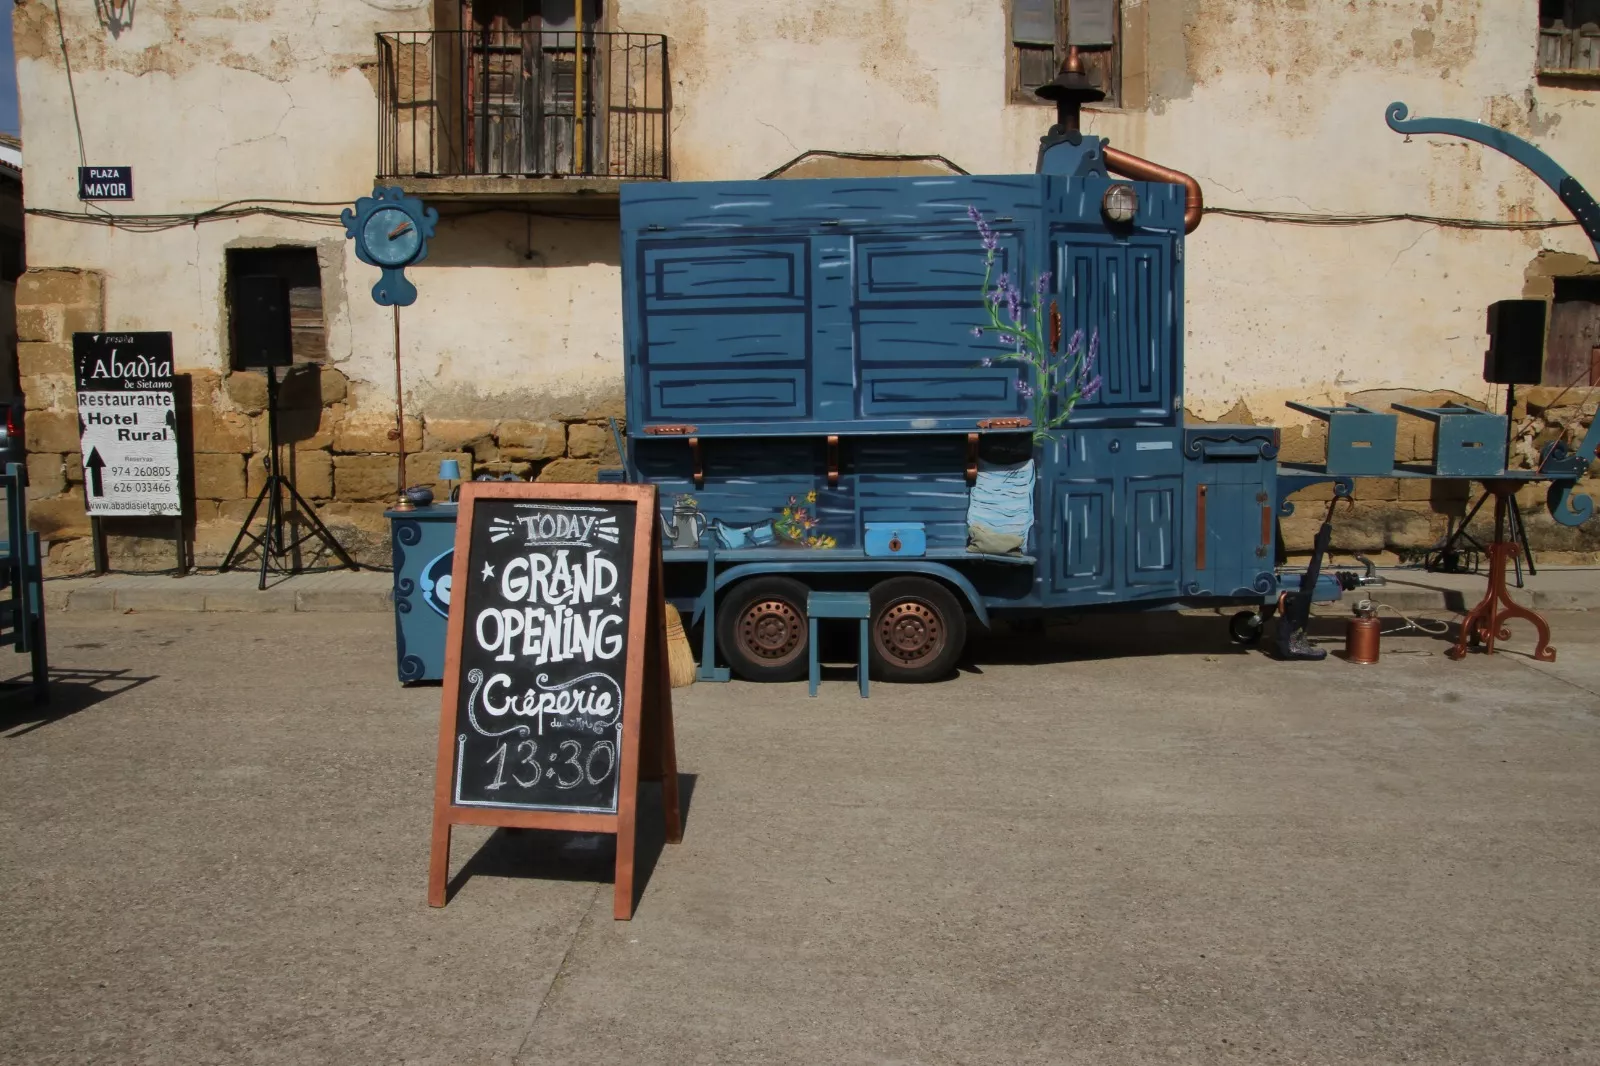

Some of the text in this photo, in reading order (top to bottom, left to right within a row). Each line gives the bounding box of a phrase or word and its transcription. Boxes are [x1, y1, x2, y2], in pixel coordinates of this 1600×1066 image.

[90, 169, 119, 178] PLAZA
[84, 183, 126, 196] MAYOR
[90, 349, 171, 378] Abadía
[124, 379, 172, 389] de Sietamo
[79, 393, 171, 406] Restaurante
[88, 412, 138, 425] Hotel
[117, 427, 167, 441] Rural
[111, 466, 171, 477] 974 260805
[113, 482, 171, 493] 626 033466
[517, 512, 597, 541] TODAY
[501, 549, 618, 605] GRAND
[483, 673, 614, 735] Crêperie
[484, 740, 615, 790] 13:30
